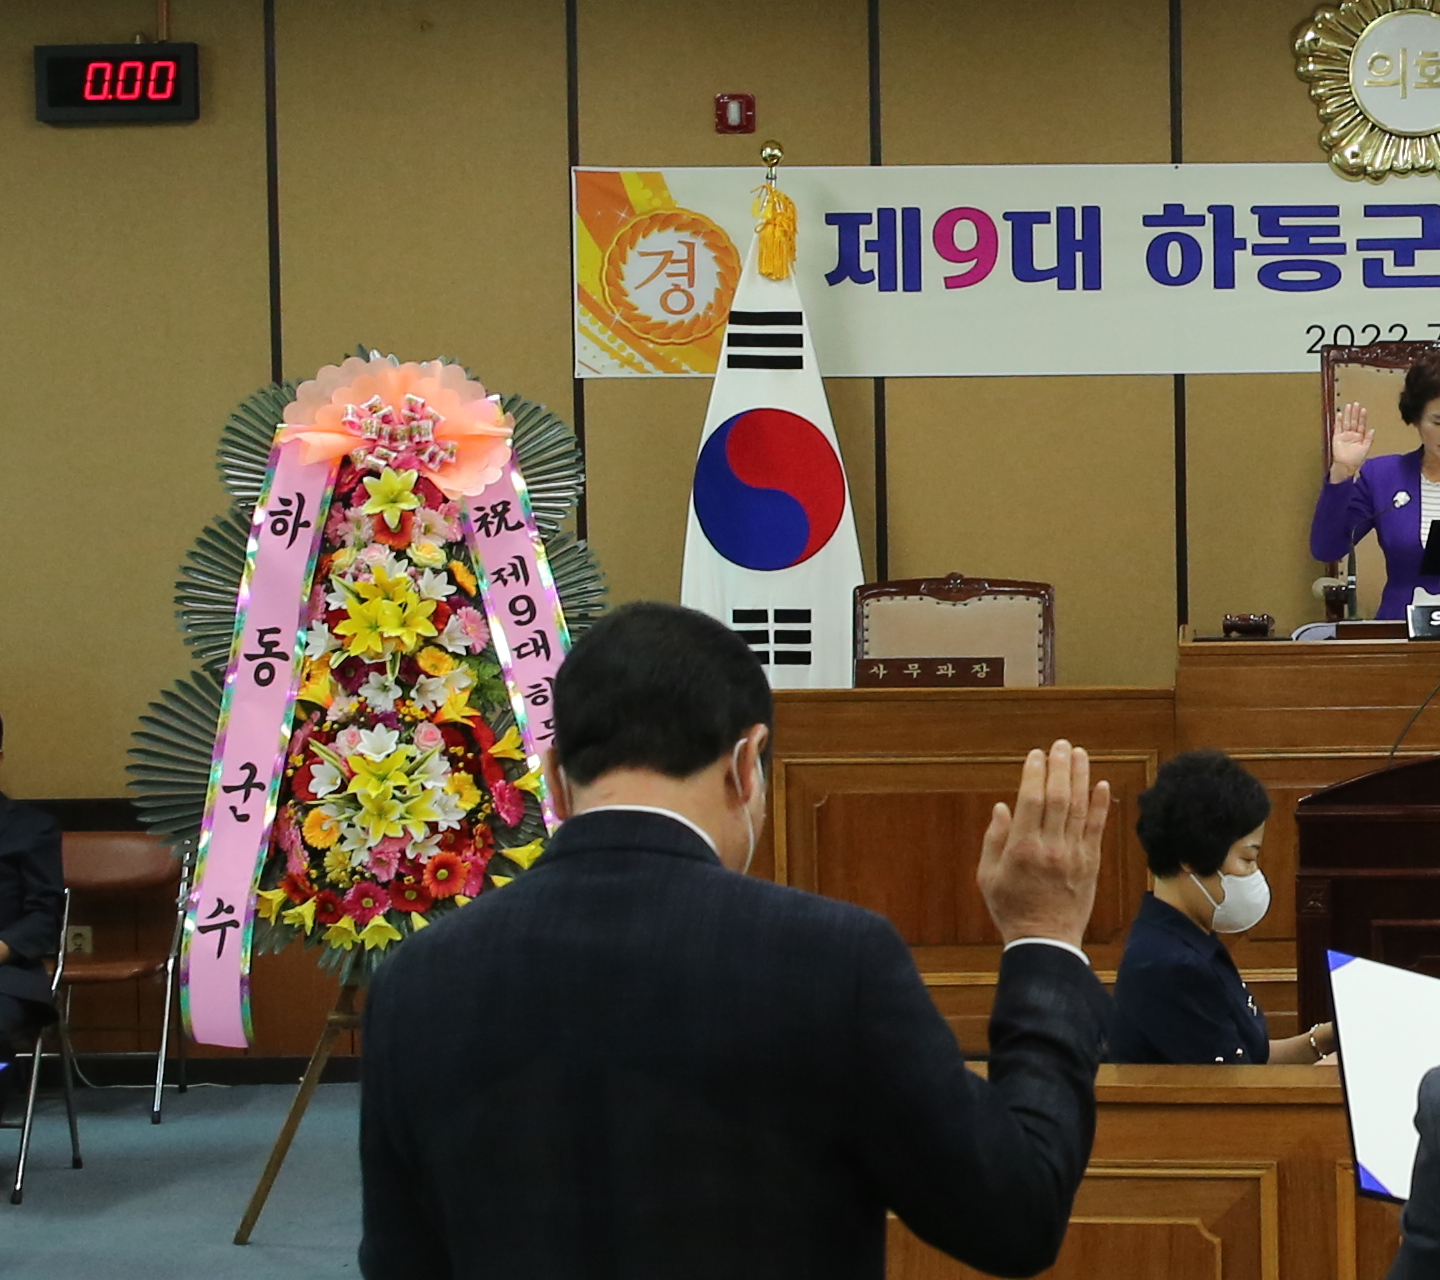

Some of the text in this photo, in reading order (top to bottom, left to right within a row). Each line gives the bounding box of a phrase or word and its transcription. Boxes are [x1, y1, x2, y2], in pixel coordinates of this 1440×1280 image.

[84, 60, 176, 101] 0.00
[634, 239, 697, 317] 경
[824, 205, 1102, 293] 제9대
[473, 500, 526, 538] 祝
[491, 555, 551, 662] 제9대
[868, 662, 991, 680] 사무과장
[198, 492, 312, 959] 하동군수
